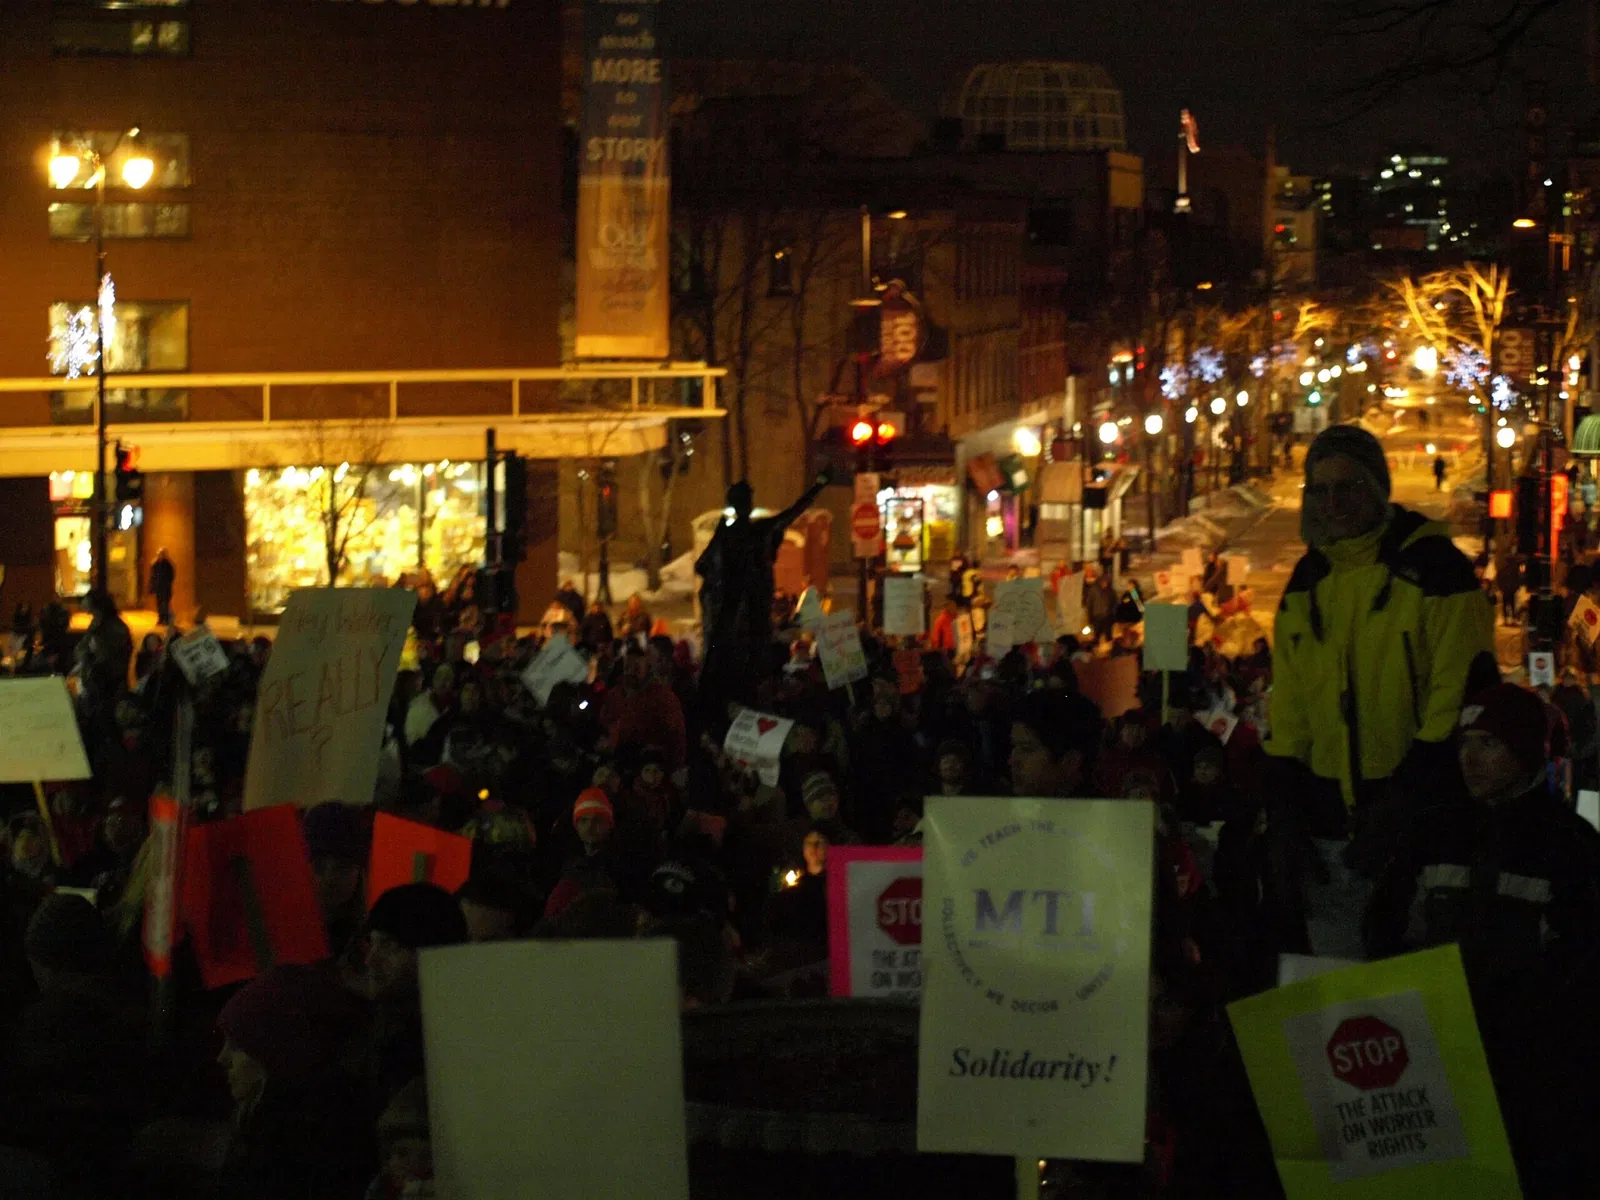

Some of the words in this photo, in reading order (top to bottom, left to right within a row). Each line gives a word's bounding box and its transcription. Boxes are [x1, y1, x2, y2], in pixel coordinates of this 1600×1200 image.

[592, 58, 662, 84] MORE
[586, 136, 666, 162] STORY
[262, 632, 398, 743] REALLY
[880, 899, 922, 926] STO
[973, 888, 1097, 937] MTI
[949, 1047, 1118, 1089] Solidarity!
[1332, 1036, 1400, 1074] STOP
[1337, 1096, 1367, 1121] THE
[1372, 1087, 1429, 1114] ATTACK
[1343, 1123, 1366, 1144] ON
[1368, 1110, 1438, 1136] WORKER
[1367, 1132, 1428, 1160] RIGHTS
